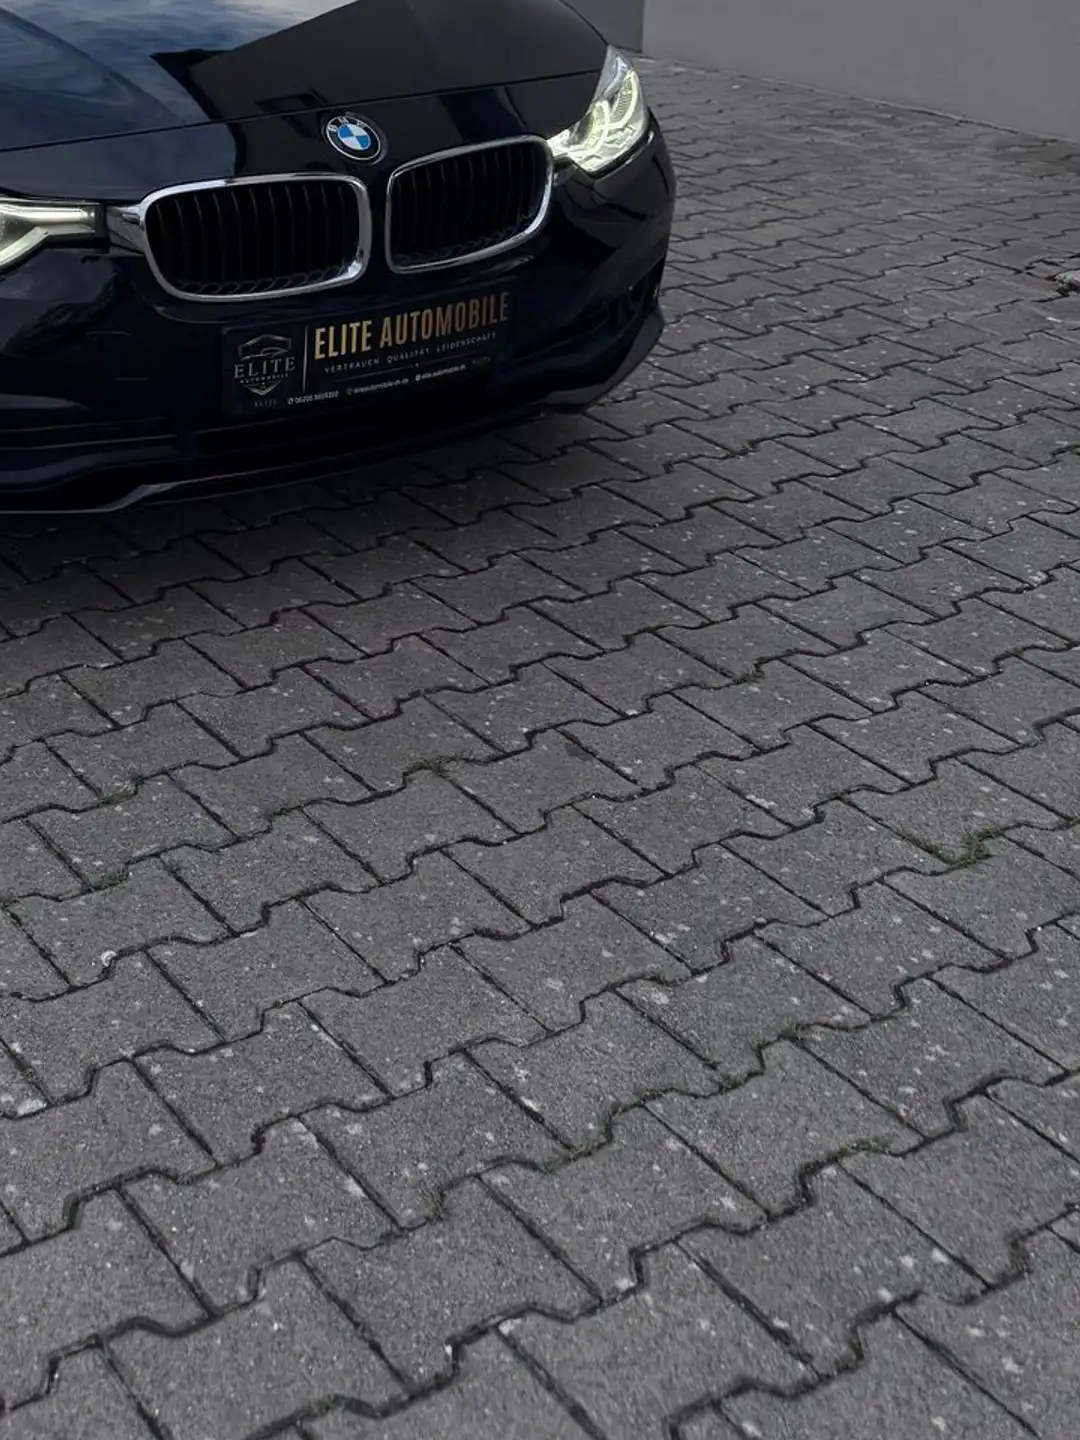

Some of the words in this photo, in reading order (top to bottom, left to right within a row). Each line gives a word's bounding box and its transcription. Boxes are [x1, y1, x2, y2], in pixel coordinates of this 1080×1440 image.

[314, 320, 373, 360] ELITE
[379, 292, 511, 349] AUTOMOBILE
[233, 356, 296, 379] ELITE
